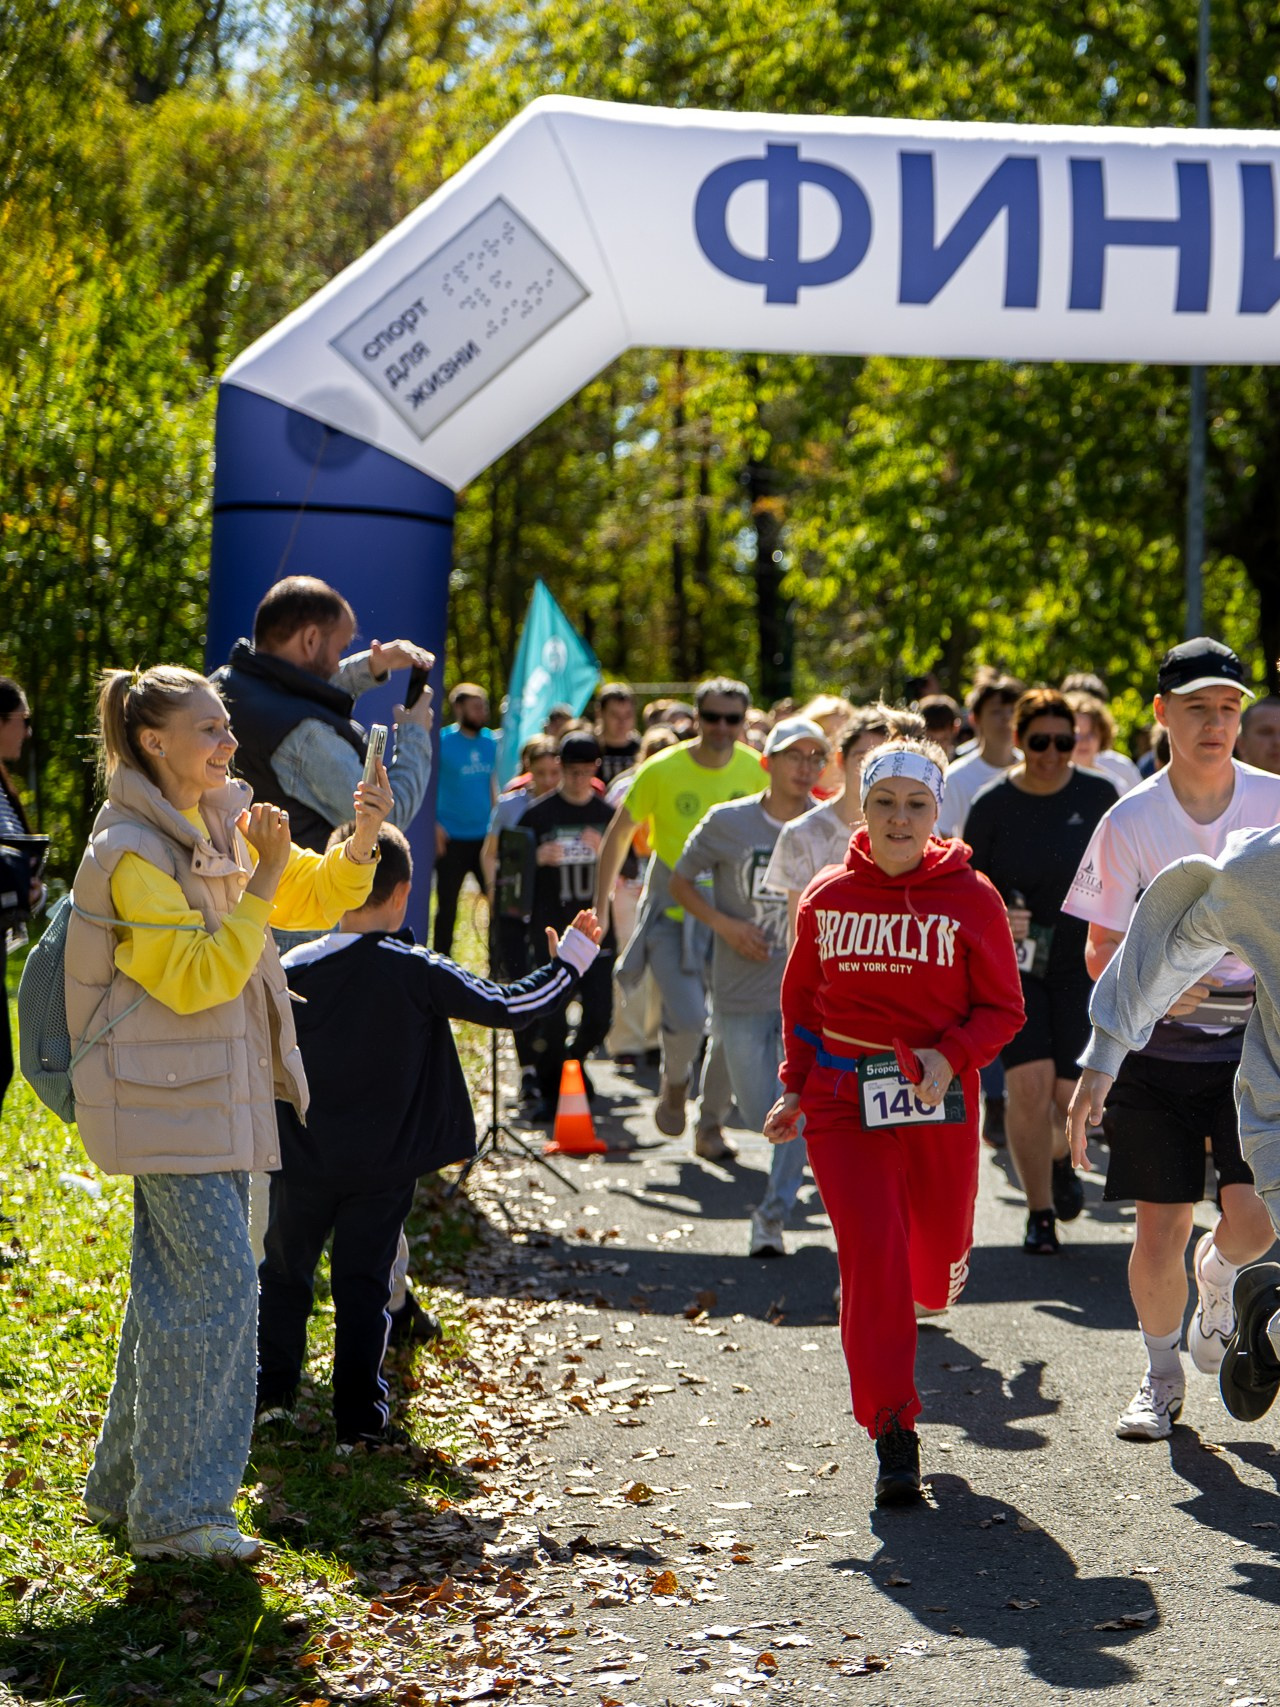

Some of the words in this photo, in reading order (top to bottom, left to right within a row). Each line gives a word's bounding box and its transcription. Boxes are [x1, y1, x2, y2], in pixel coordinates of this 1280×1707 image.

[361, 296, 429, 362] спорт
[383, 340, 431, 390] для
[405, 339, 481, 411] жизни
[1077, 871, 1102, 890] ОЛГА
[815, 909, 960, 967] BROOKLYN
[839, 962, 857, 972] NEW
[862, 962, 888, 972] YORK
[890, 963, 913, 974] CITY
[867, 1064, 873, 1075] 5
[874, 1064, 899, 1075] город
